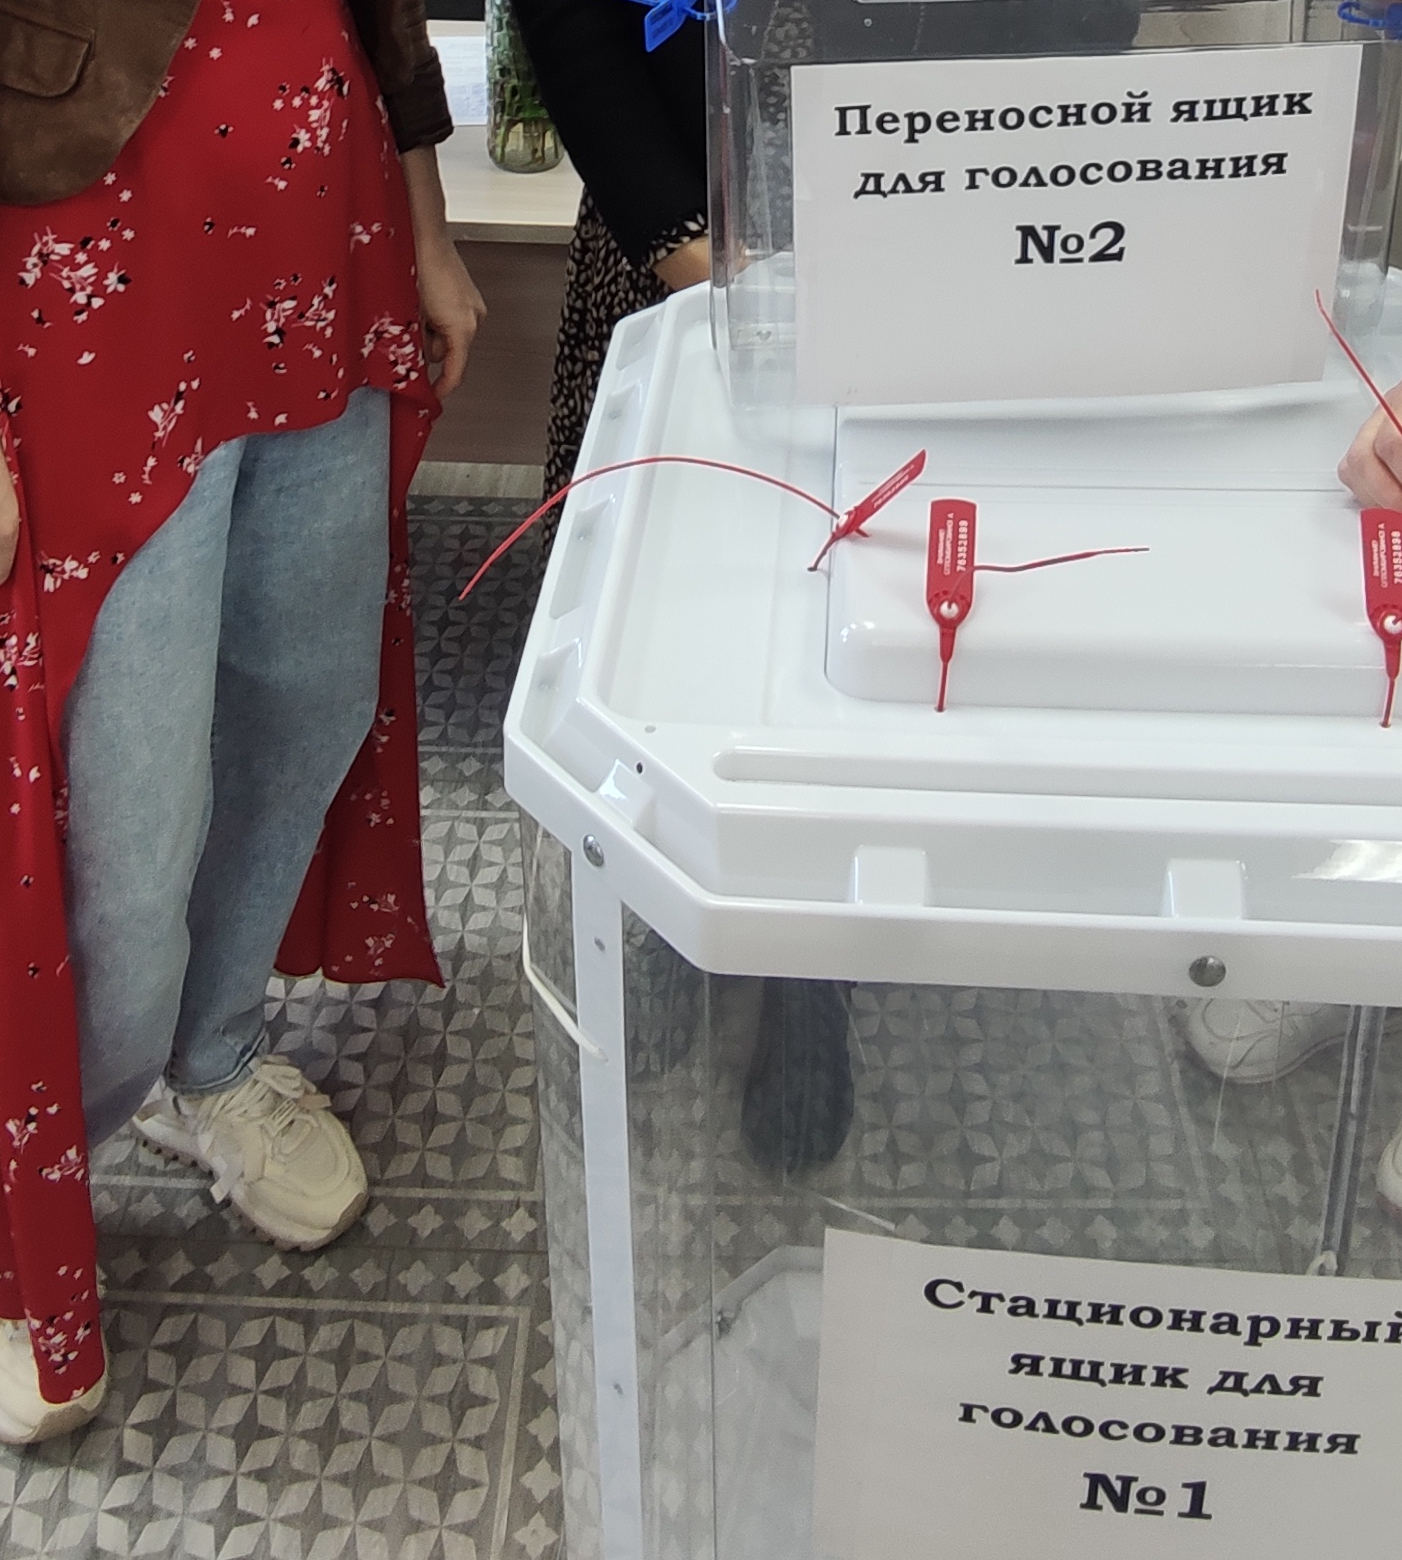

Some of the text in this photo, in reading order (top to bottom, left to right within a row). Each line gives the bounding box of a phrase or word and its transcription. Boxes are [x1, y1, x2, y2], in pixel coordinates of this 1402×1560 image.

[833, 90, 1314, 144] Переносной ящик
[852, 151, 1289, 200] для голосования
[1013, 220, 1126, 265] №2
[1007, 1352, 1325, 1398] ящик для
[957, 1402, 1362, 1455] голосования
